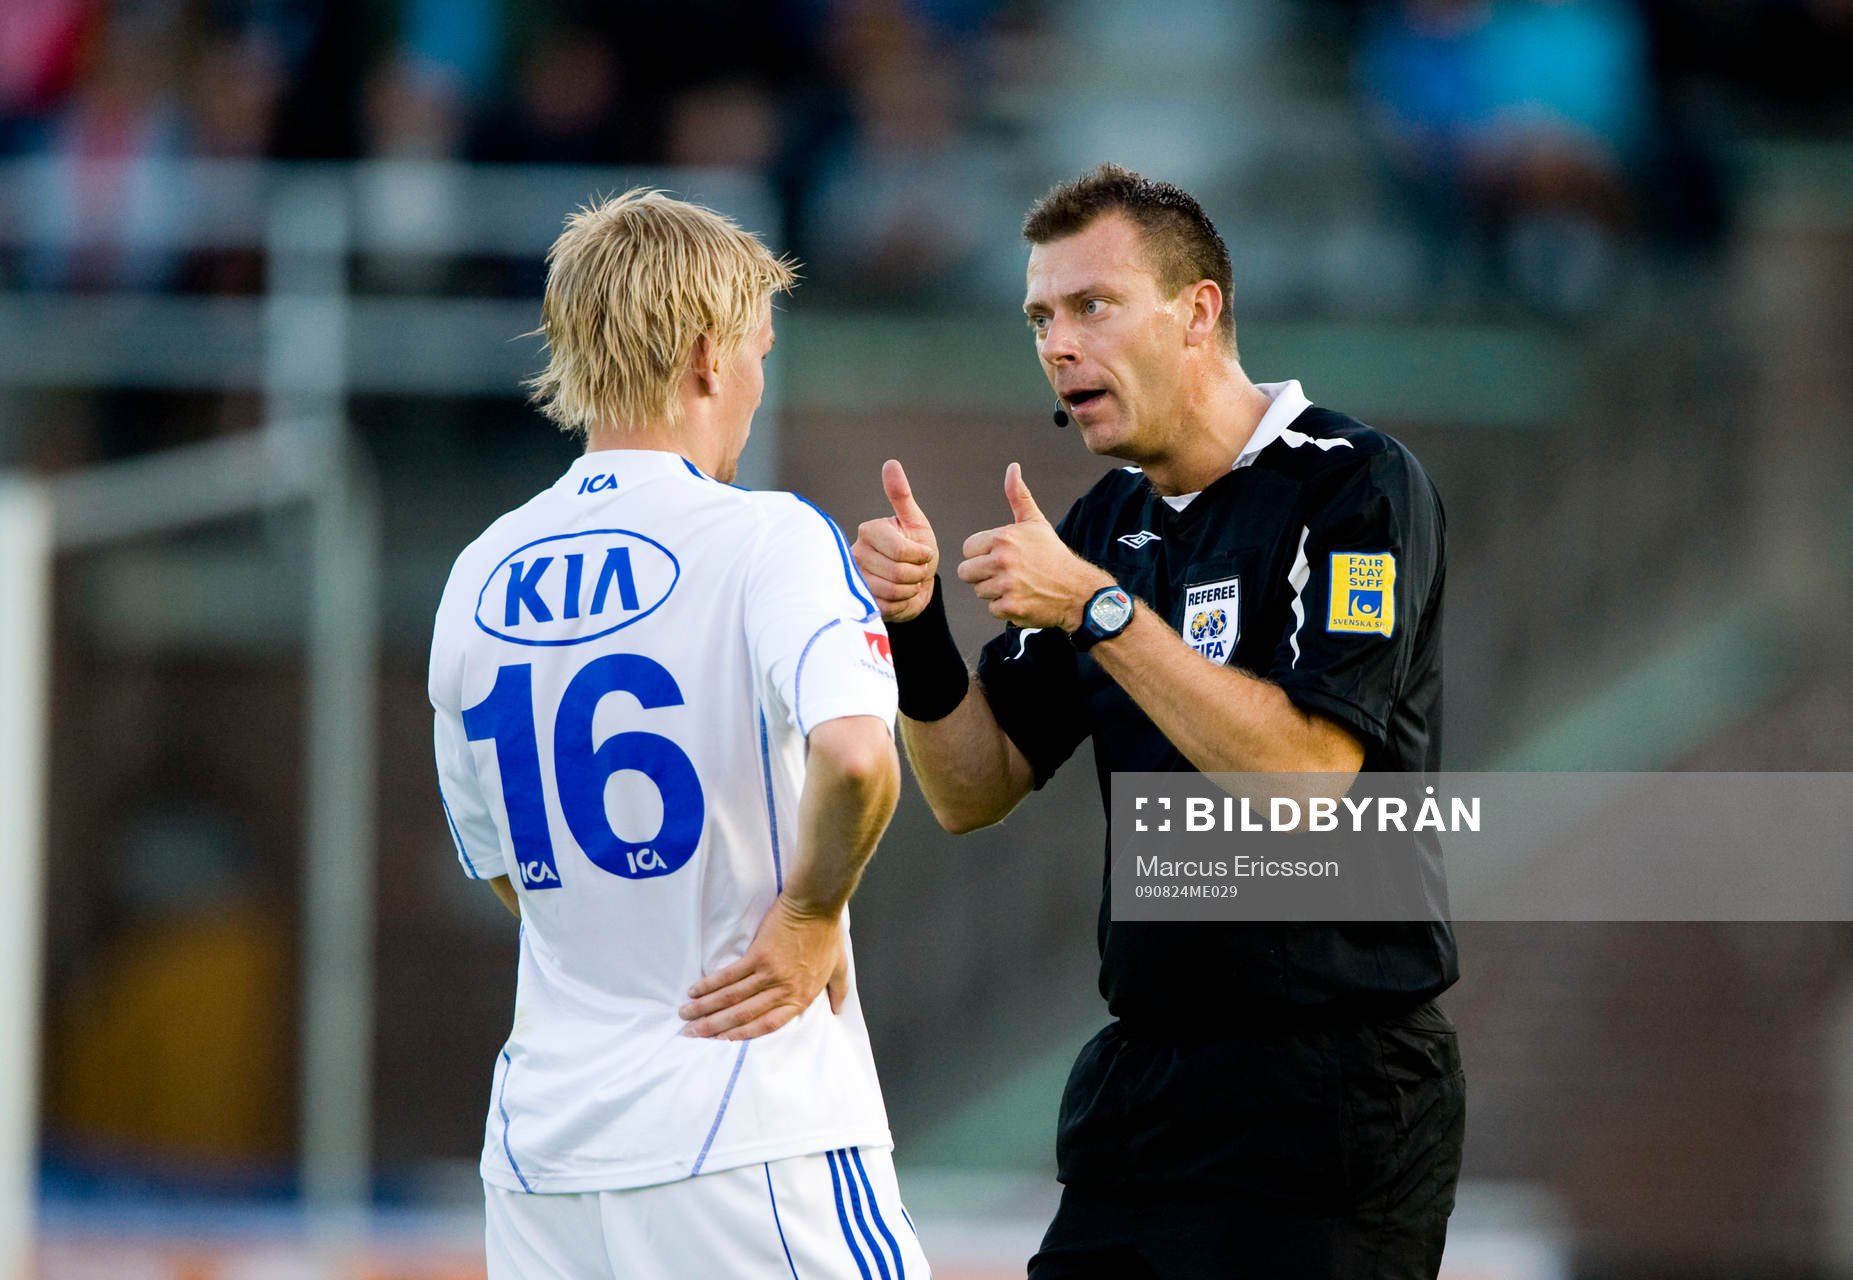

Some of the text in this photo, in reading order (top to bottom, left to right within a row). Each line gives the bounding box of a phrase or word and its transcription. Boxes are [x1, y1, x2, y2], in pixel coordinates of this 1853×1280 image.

[577, 473, 618, 495] ICA
[1349, 557, 1383, 567] FAIR
[1349, 567, 1383, 577] PLAY
[504, 546, 640, 627] KIA
[1349, 577, 1383, 588] SvFF
[1188, 584, 1236, 606] REFEREE
[1332, 618, 1372, 628] SVENSKA
[461, 653, 705, 890] 16
[519, 861, 559, 883] ICA
[626, 848, 668, 874] ICA
